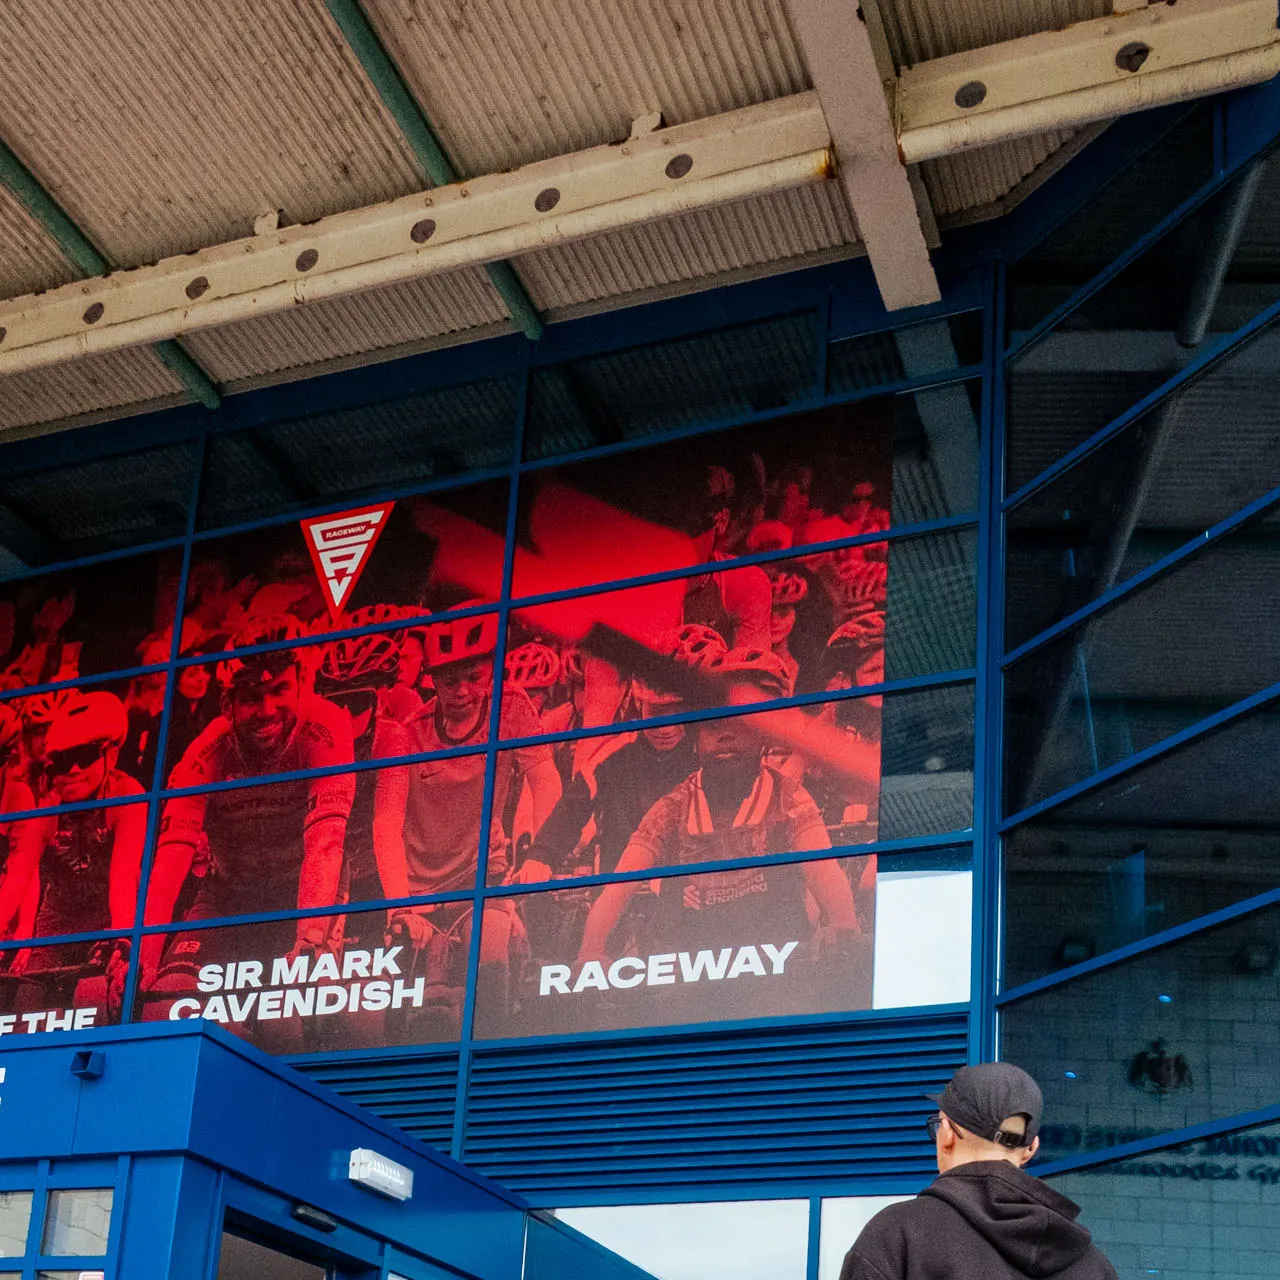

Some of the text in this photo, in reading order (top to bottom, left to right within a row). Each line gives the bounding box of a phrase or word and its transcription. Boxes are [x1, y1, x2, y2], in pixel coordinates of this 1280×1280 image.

[326, 525, 366, 538] RACEWAY
[198, 946, 404, 992] SIR MARK
[539, 941, 799, 996] RACEWAY
[21, 1008, 97, 1034] THE
[169, 977, 425, 1024] CAVENDISH
